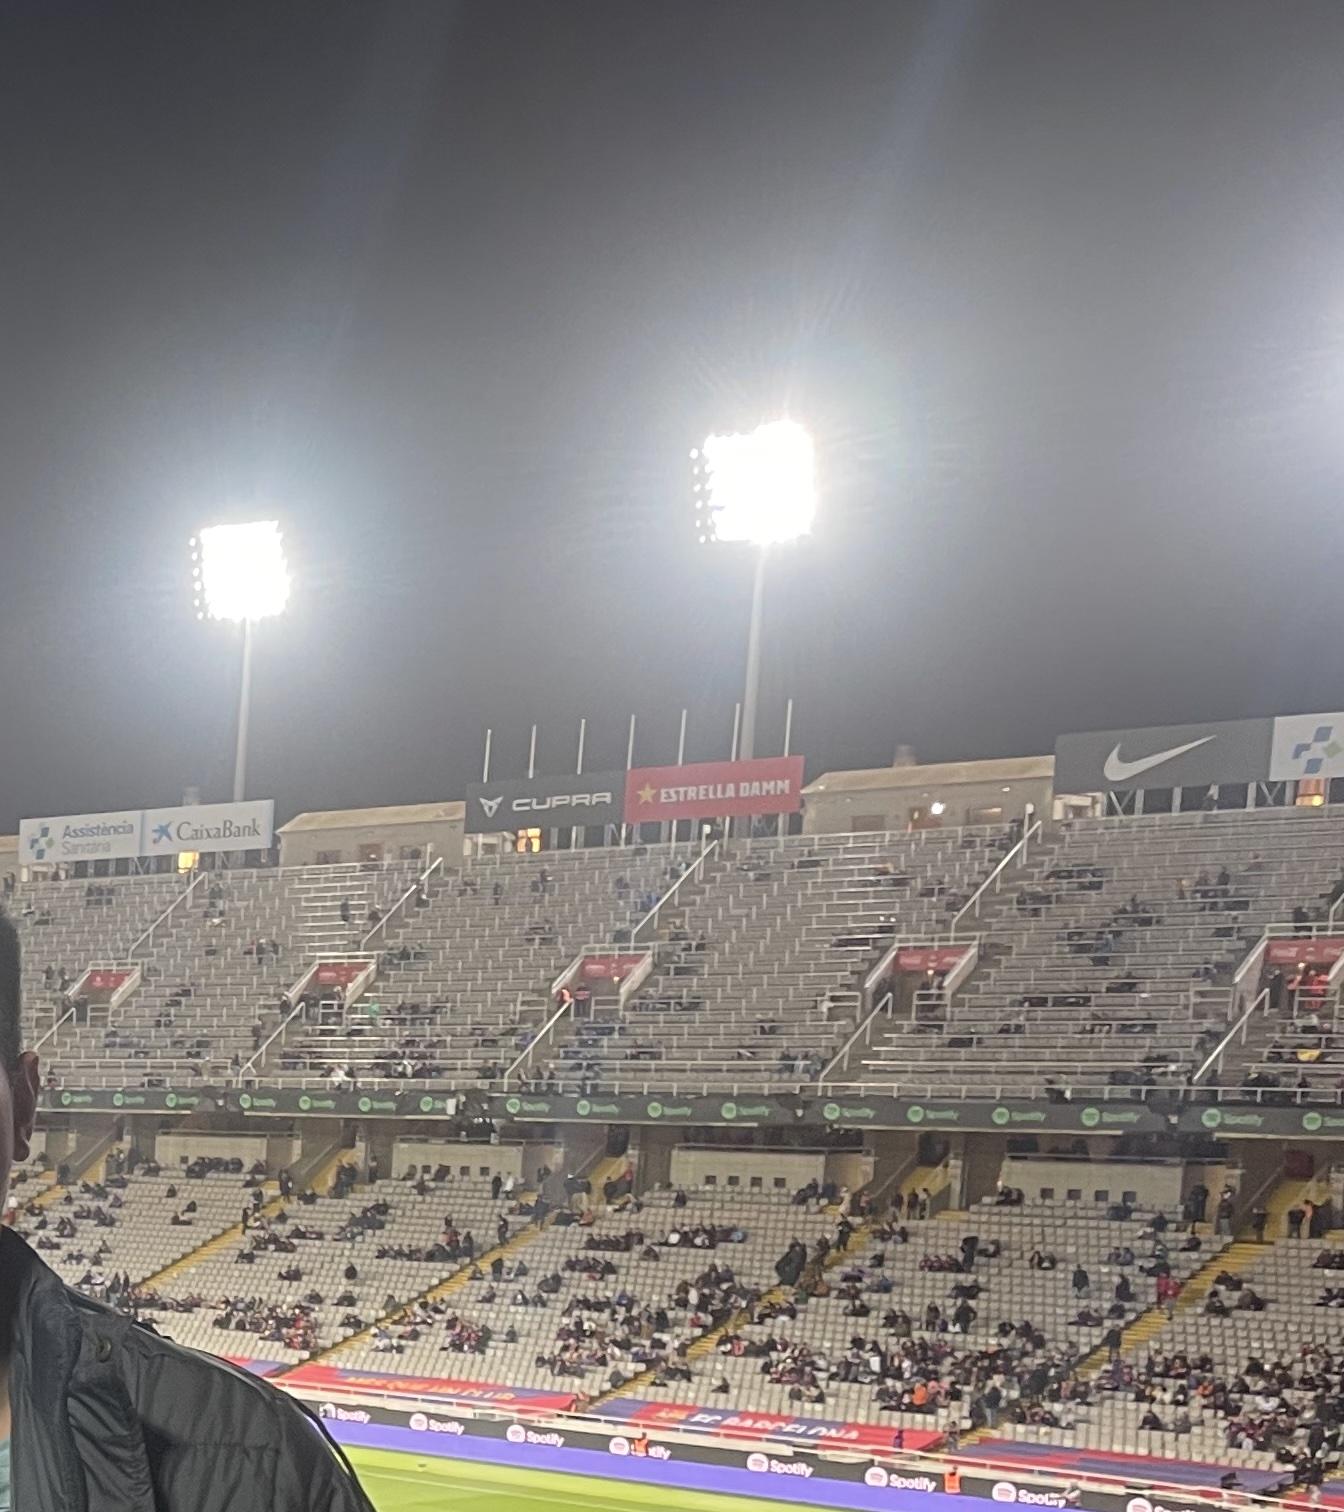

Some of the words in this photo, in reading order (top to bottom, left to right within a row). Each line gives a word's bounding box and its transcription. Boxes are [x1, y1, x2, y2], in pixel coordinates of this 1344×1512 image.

[660, 783, 736, 803] ESTRELLA
[739, 779, 791, 797] DAMM
[512, 791, 611, 811] CUPRA
[176, 818, 262, 842] CaixaBank
[337, 1407, 371, 1425] Spotify
[429, 1418, 464, 1436] Spotify
[526, 1430, 566, 1448] Spotify
[770, 1459, 813, 1478] Spotify
[889, 1473, 937, 1493] Spotify
